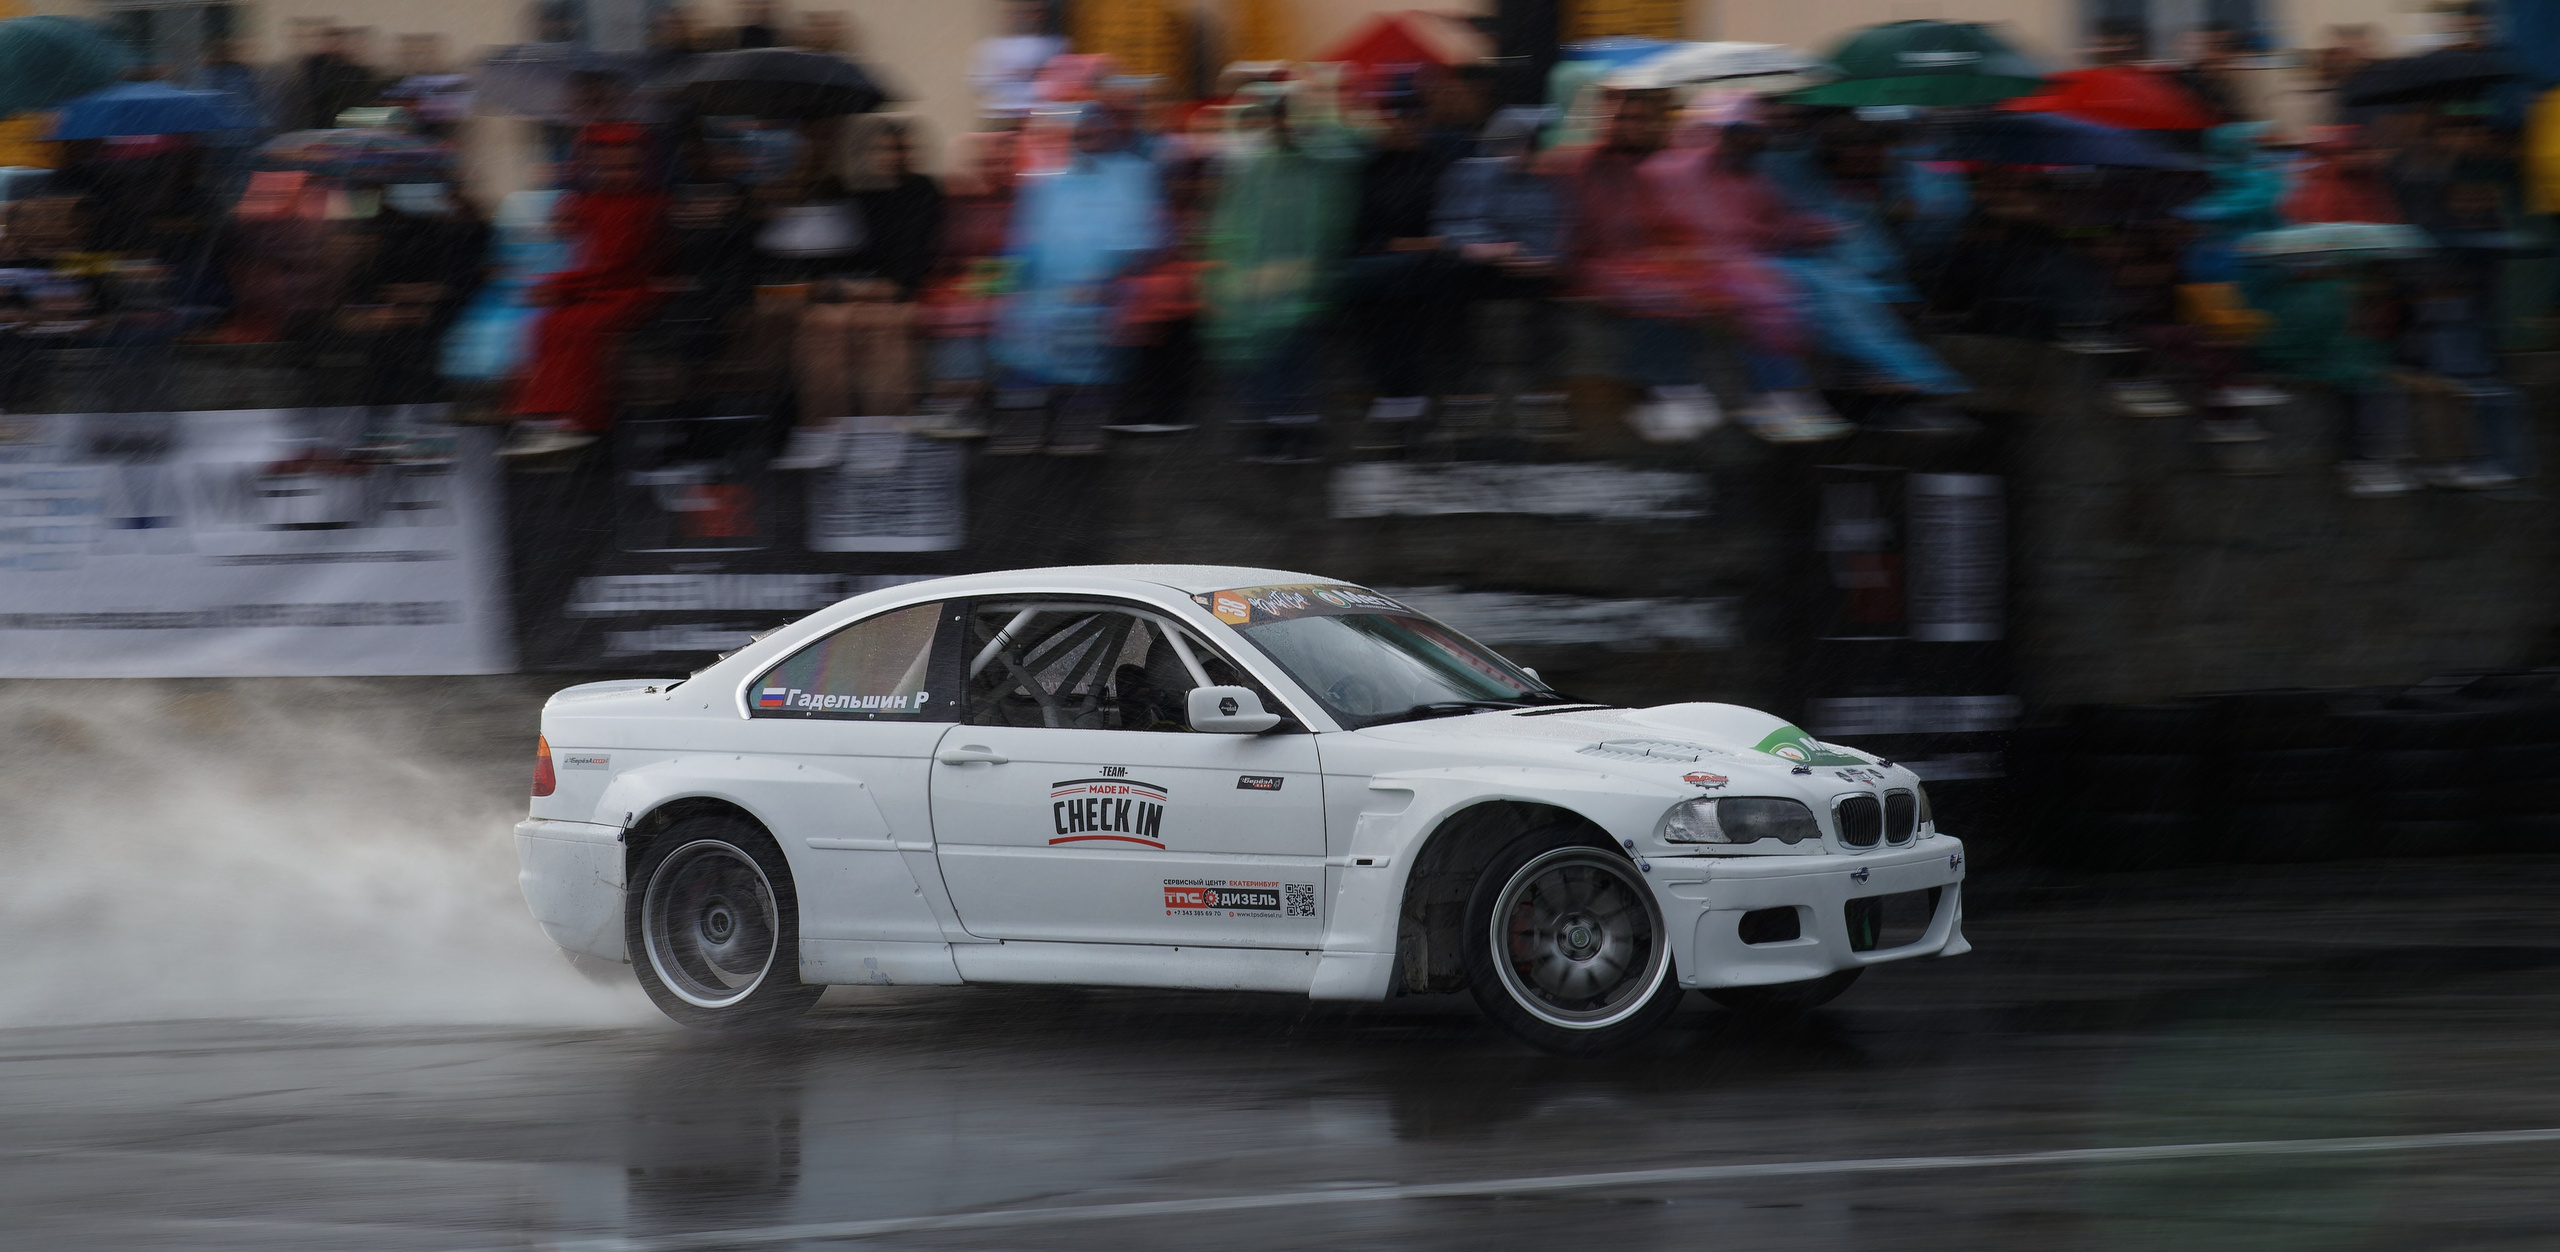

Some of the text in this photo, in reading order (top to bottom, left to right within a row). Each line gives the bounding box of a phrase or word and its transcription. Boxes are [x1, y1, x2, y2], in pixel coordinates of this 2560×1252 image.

[1217, 597, 1247, 617] 38
[786, 689, 908, 711] Гадельшин
[1089, 785, 1130, 795] MADE IN
[1053, 798, 1164, 838] CHECK IN
[1229, 880, 1279, 888] ЕКАТЕРИНБУРГ
[1164, 892, 1277, 906] ТПС ДИЗЕЛЬ
